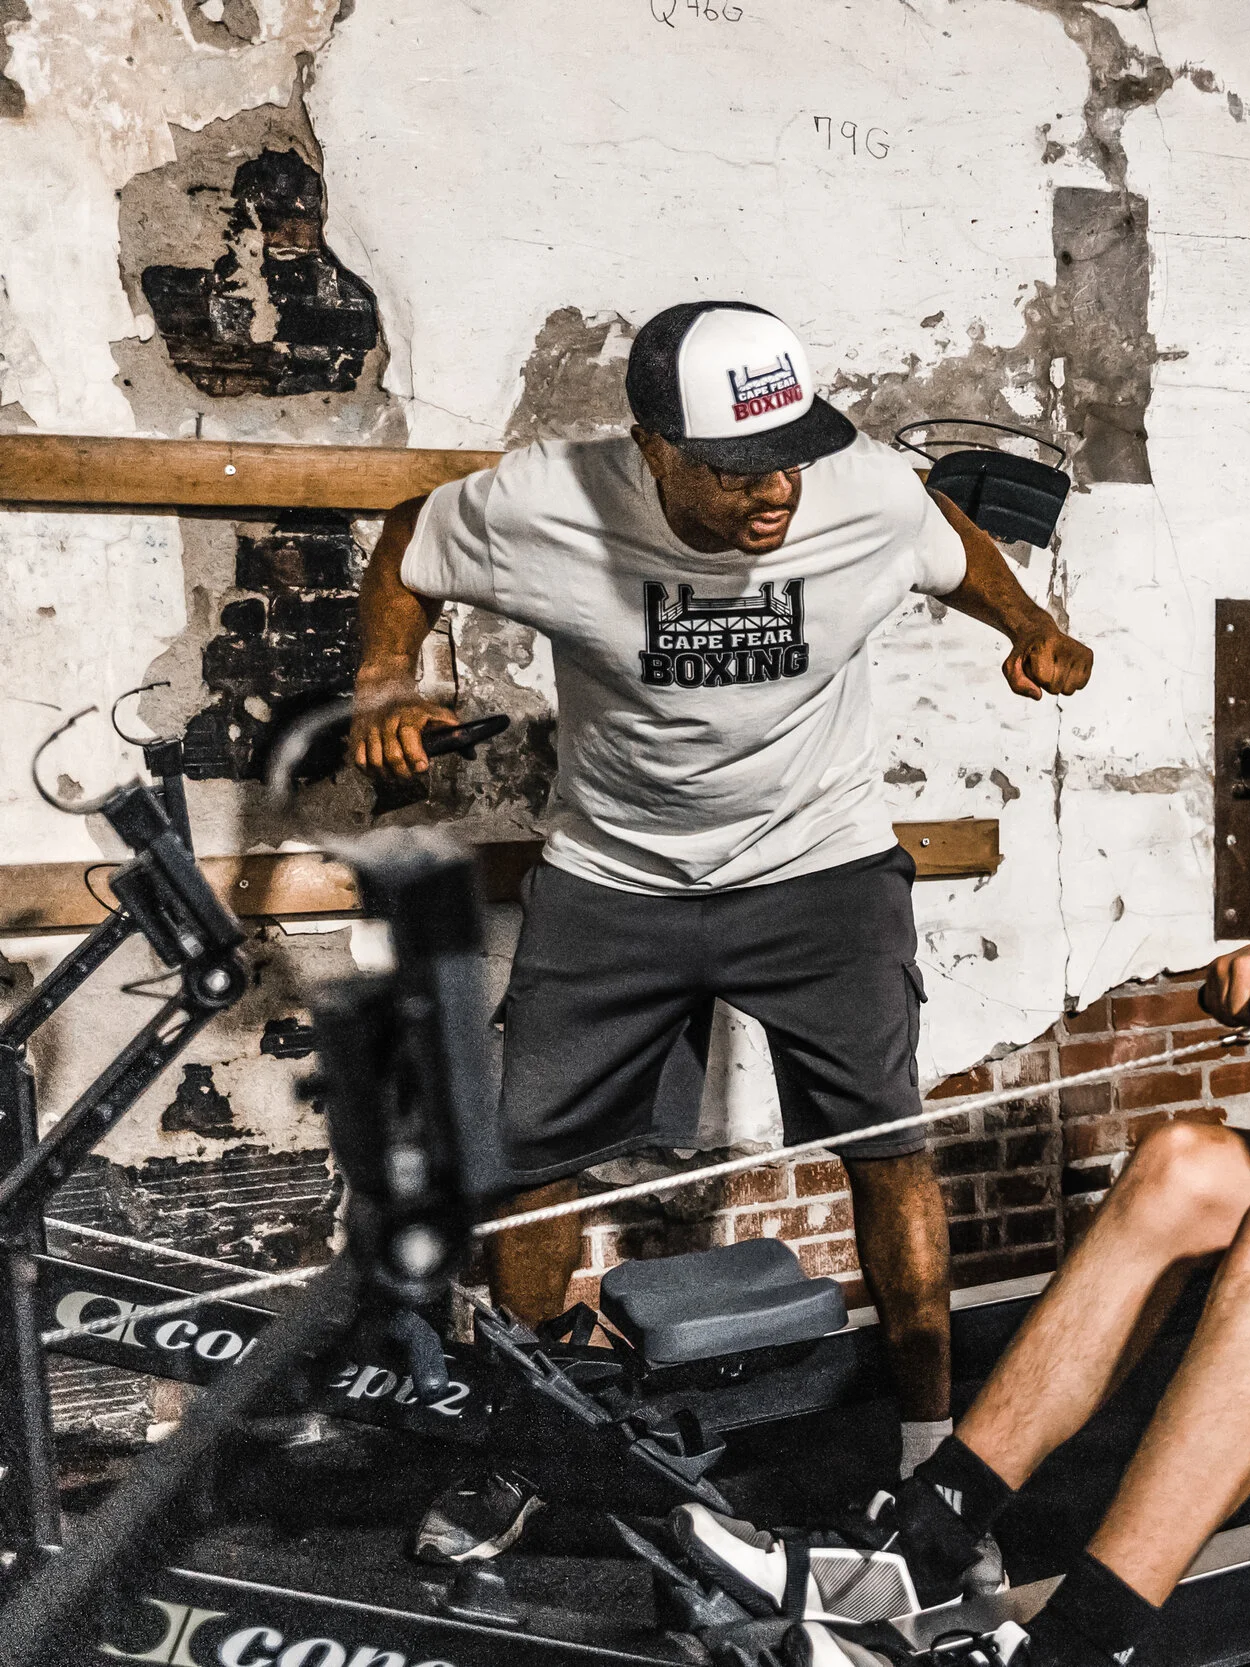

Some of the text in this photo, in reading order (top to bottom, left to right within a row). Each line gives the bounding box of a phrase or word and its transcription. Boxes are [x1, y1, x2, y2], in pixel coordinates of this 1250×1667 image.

[813, 116, 890, 159] 79G
[732, 384, 803, 423] BOXING
[738, 376, 796, 401] CAPE FEAR
[658, 629, 793, 650] CAPE FEAR
[638, 642, 810, 690] BOXING
